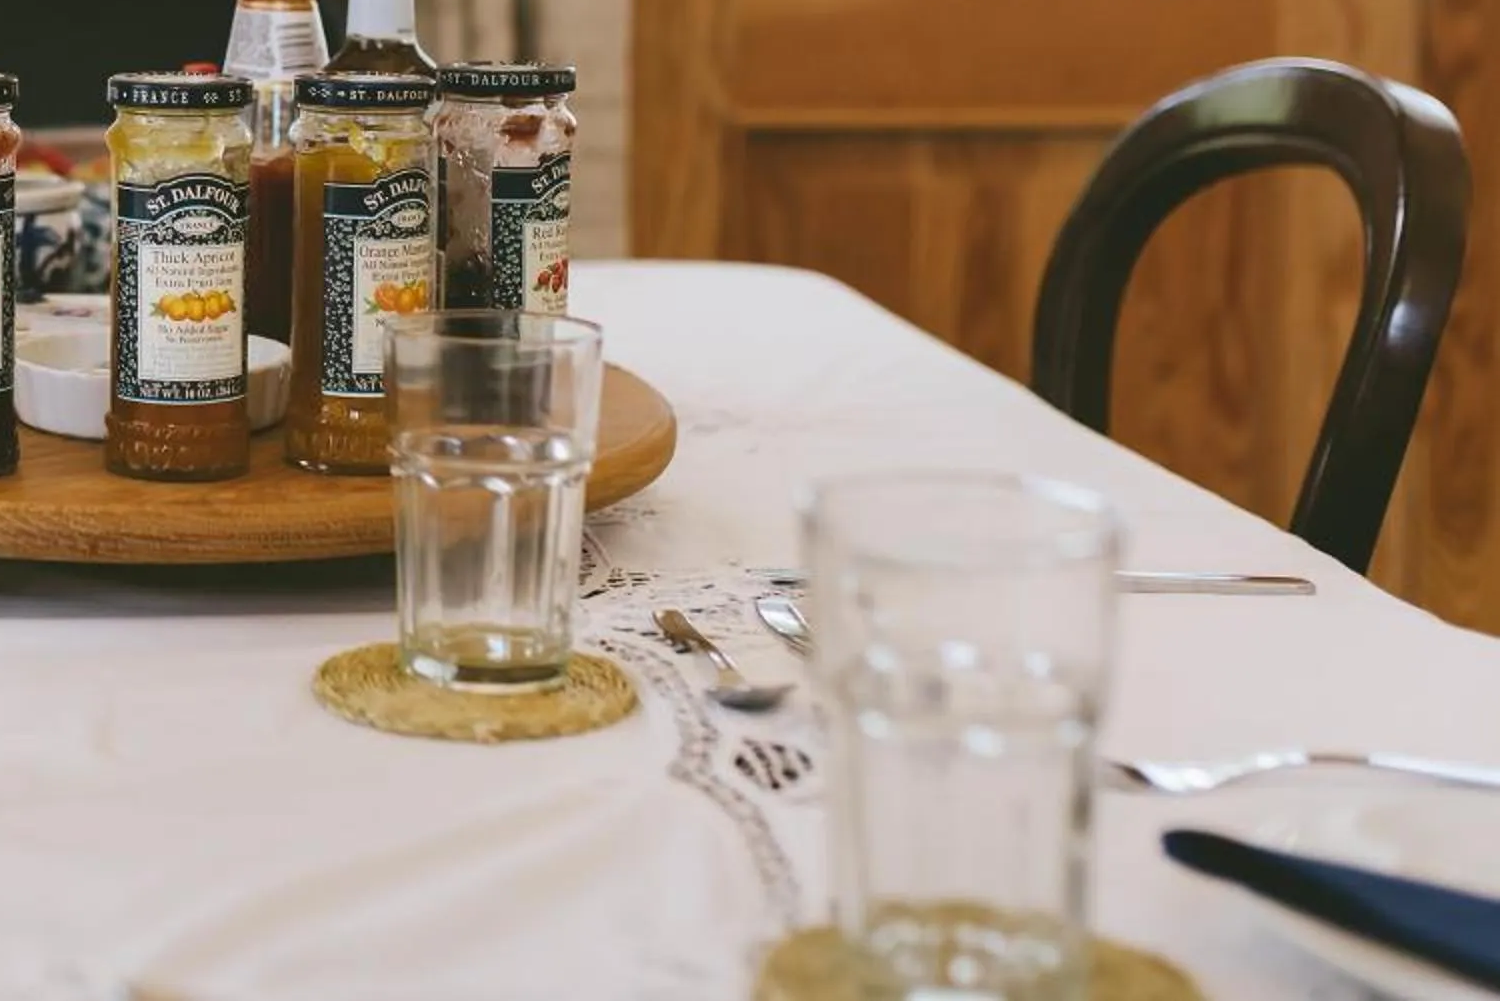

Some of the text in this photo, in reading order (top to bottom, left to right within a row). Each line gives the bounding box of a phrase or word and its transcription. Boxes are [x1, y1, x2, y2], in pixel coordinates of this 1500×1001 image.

[471, 73, 540, 86] DALFOUR
[132, 88, 189, 104] FRANCE
[349, 90, 372, 100] ST.
[145, 184, 242, 215] ST. DALFOUR
[363, 191, 389, 210] ST.
[533, 226, 553, 240] Red
[150, 250, 235, 267] Thick Apricot
[360, 245, 399, 262] Orange
